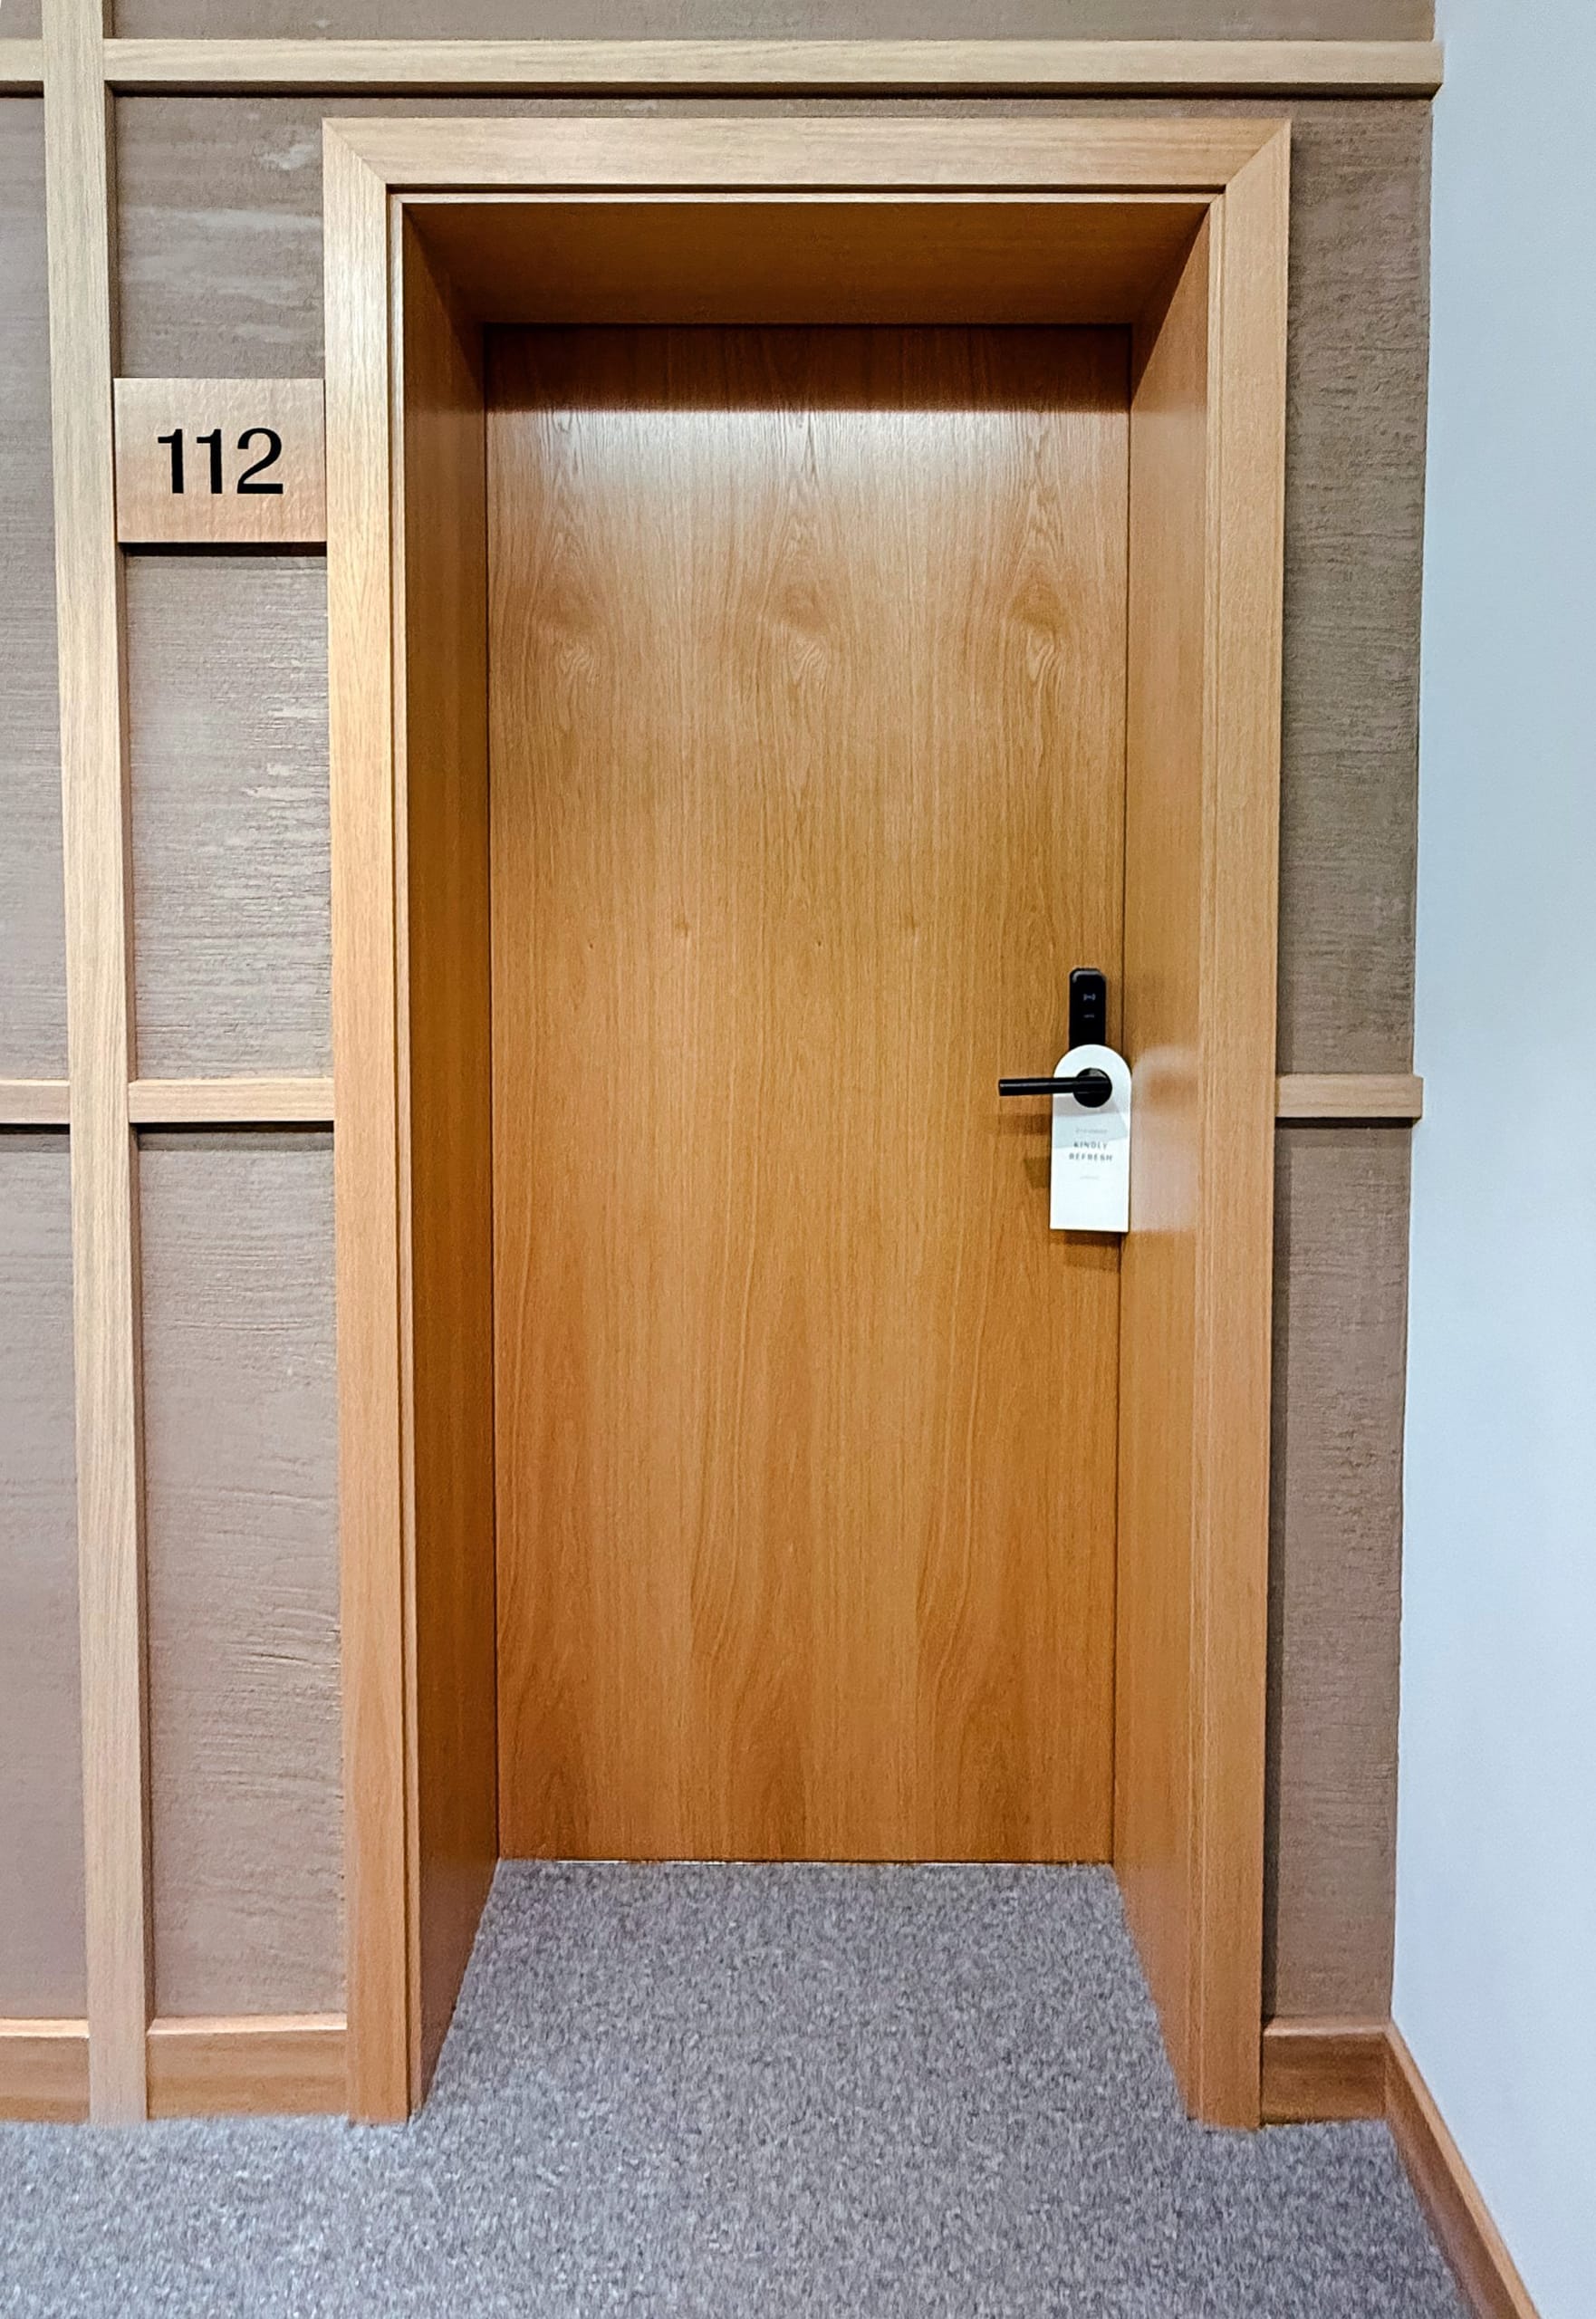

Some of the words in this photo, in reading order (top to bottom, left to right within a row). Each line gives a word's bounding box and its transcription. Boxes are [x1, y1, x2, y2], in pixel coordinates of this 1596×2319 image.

[158, 428, 284, 495] 112
[1073, 1140, 1108, 1150] KINDLY
[1069, 1152, 1113, 1161] REFRESH
